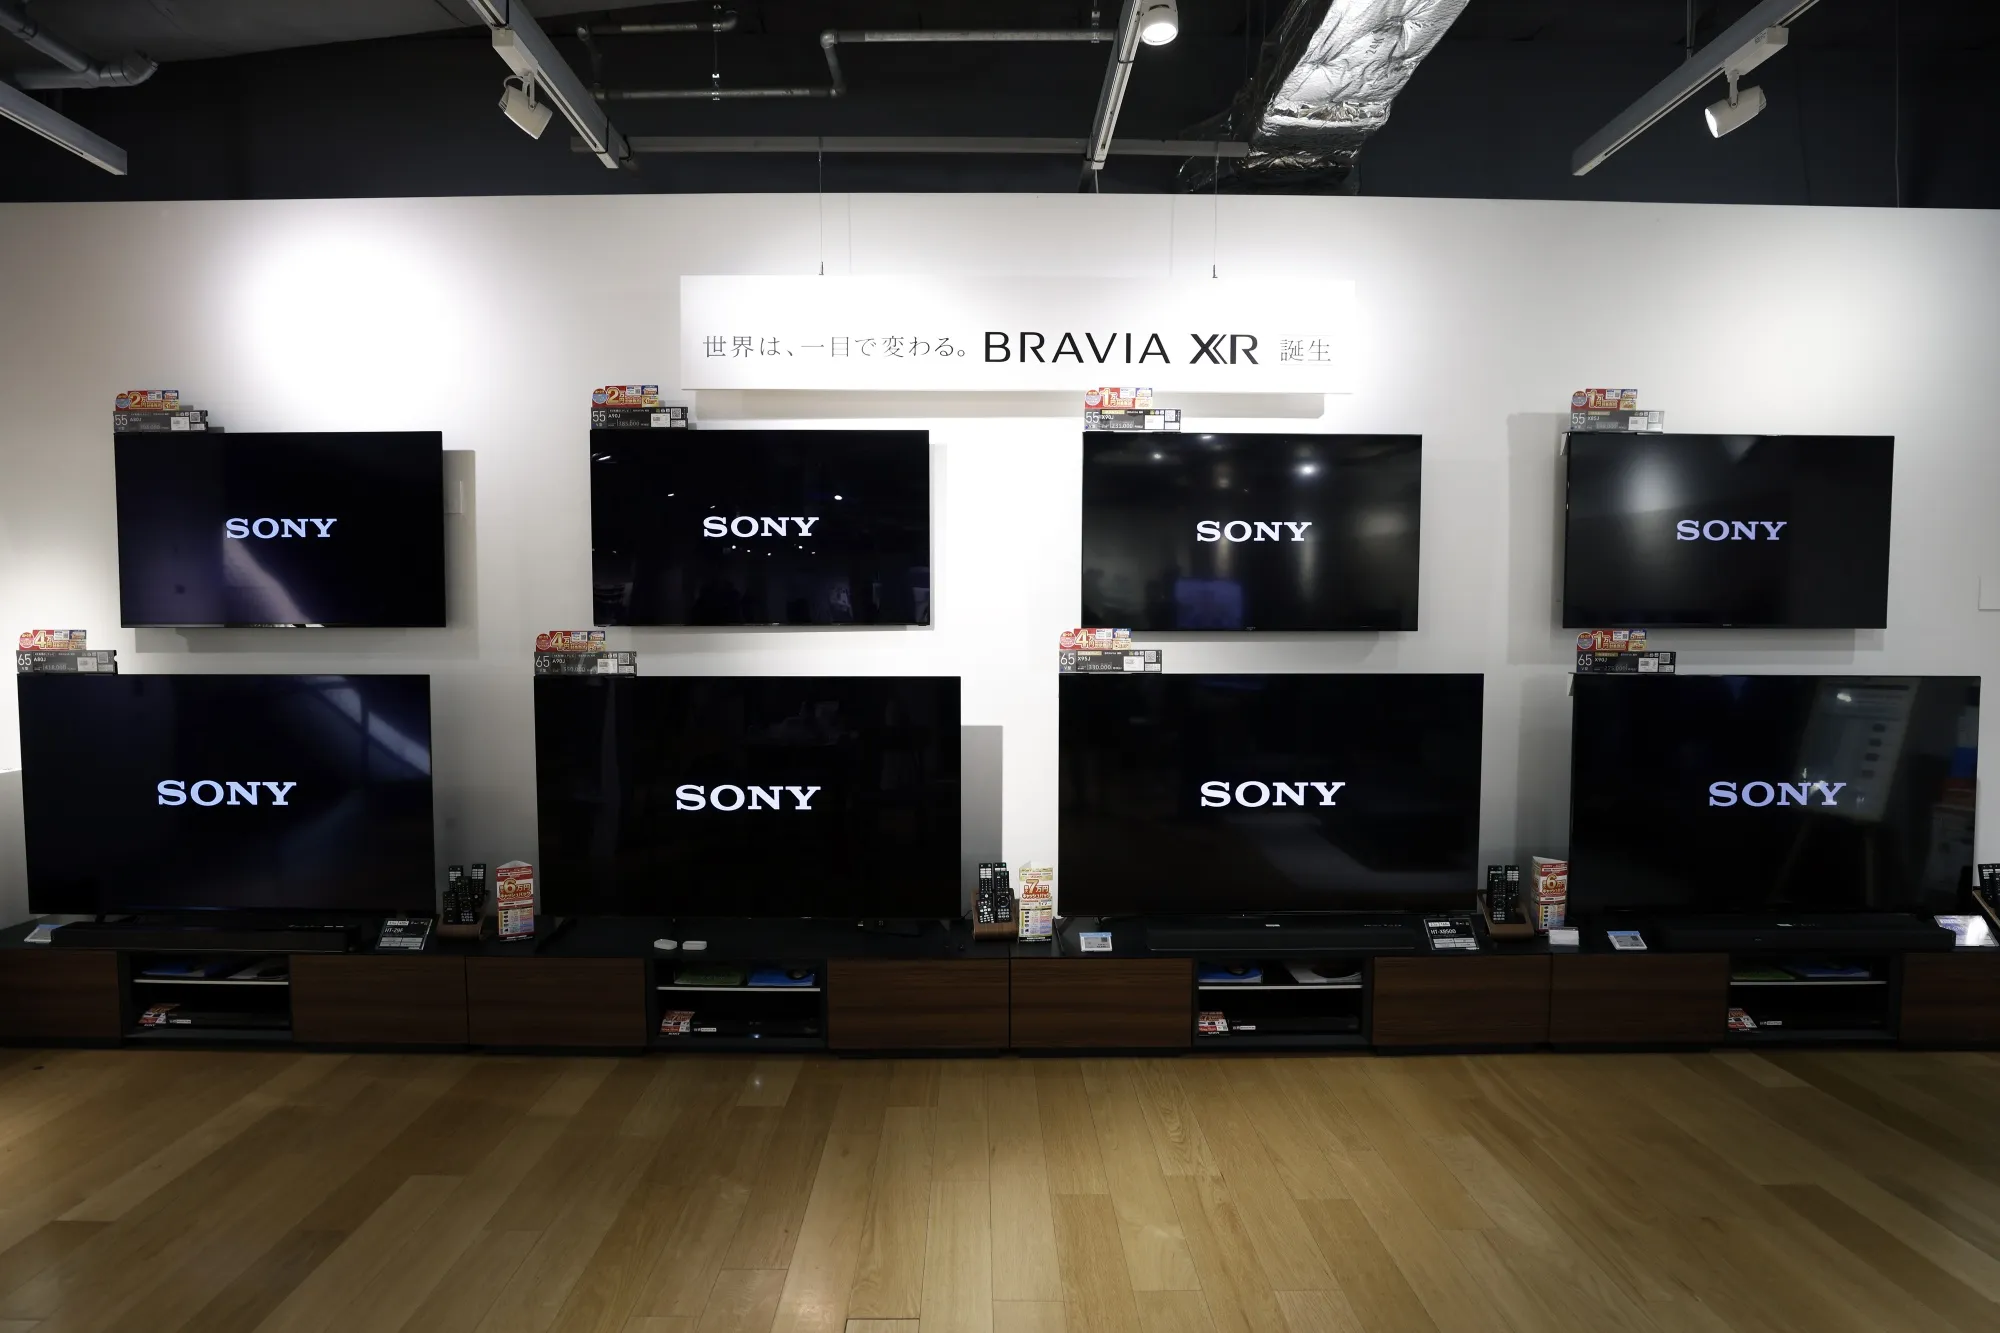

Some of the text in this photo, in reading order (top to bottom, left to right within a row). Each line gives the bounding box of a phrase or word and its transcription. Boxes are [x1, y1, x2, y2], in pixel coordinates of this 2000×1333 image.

[702, 334, 968, 359] 世界は、一目で変わる。
[984, 331, 1171, 364] BRAVIA
[1279, 338, 1332, 364] 誕生
[115, 414, 128, 425] 55
[592, 410, 606, 422] 55
[1085, 411, 1099, 423] 55
[1572, 412, 1585, 425] 55
[226, 518, 337, 538] SONY
[704, 516, 819, 537] SONY
[1197, 521, 1312, 542] SONY
[1677, 520, 1786, 540] SONY
[17, 653, 32, 665] 65
[535, 655, 550, 668] 65
[1060, 652, 1075, 665] 65
[1578, 654, 1592, 666] 65
[158, 780, 296, 806] SONY
[676, 785, 820, 810] SONY
[1201, 781, 1345, 807] SONY
[1710, 781, 1846, 806] SONY
